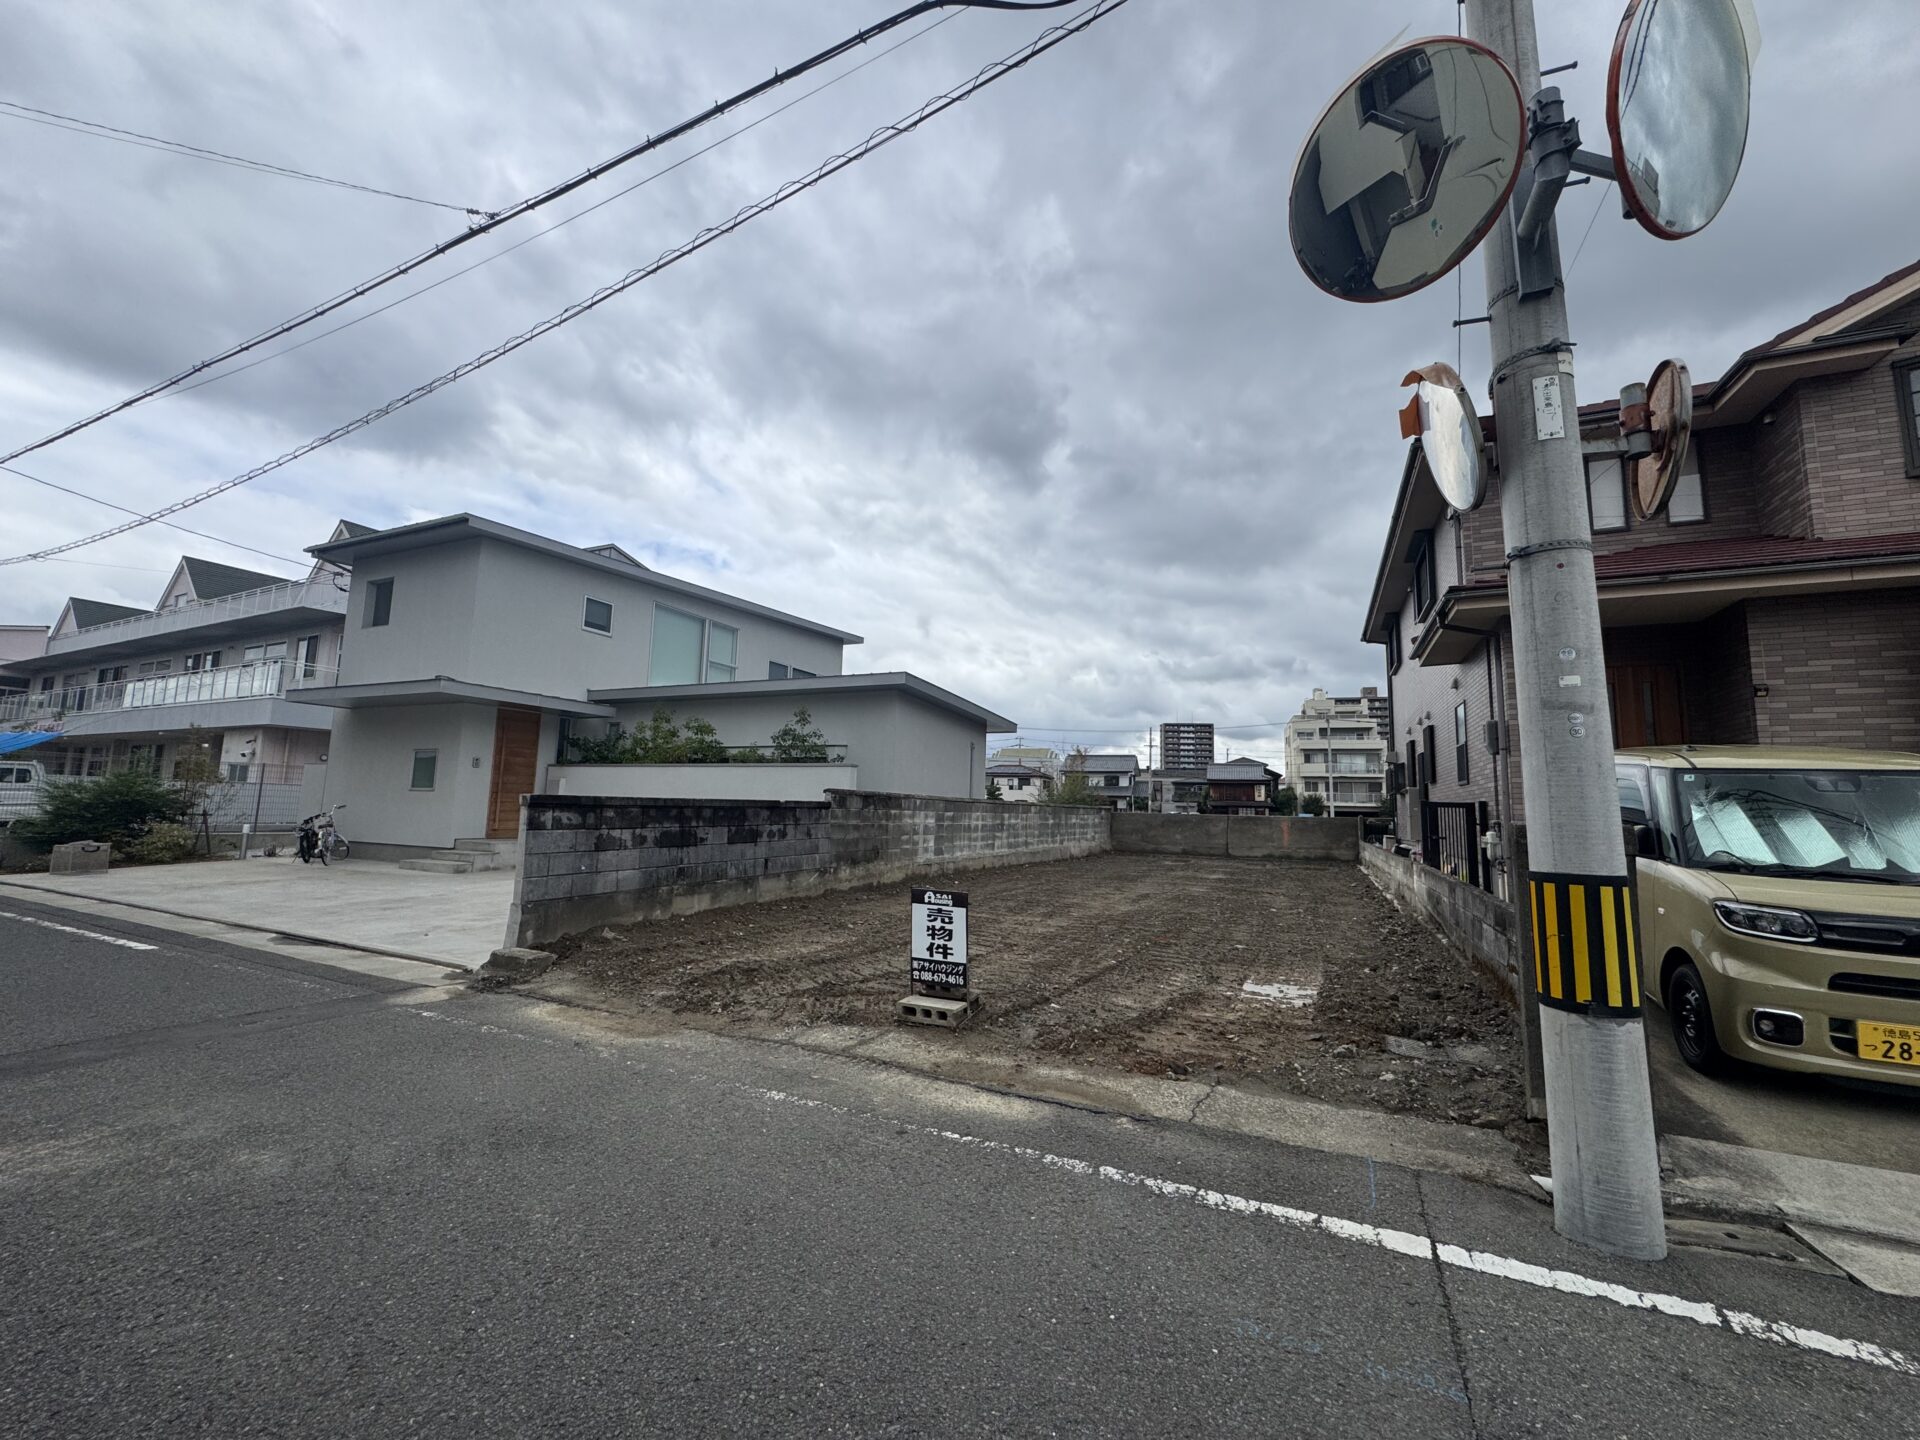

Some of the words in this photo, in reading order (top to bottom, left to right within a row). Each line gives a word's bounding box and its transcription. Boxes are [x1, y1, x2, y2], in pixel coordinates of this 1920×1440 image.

[926, 907, 954, 960] 売物件
[920, 970, 964, 985] 088-679-4616
